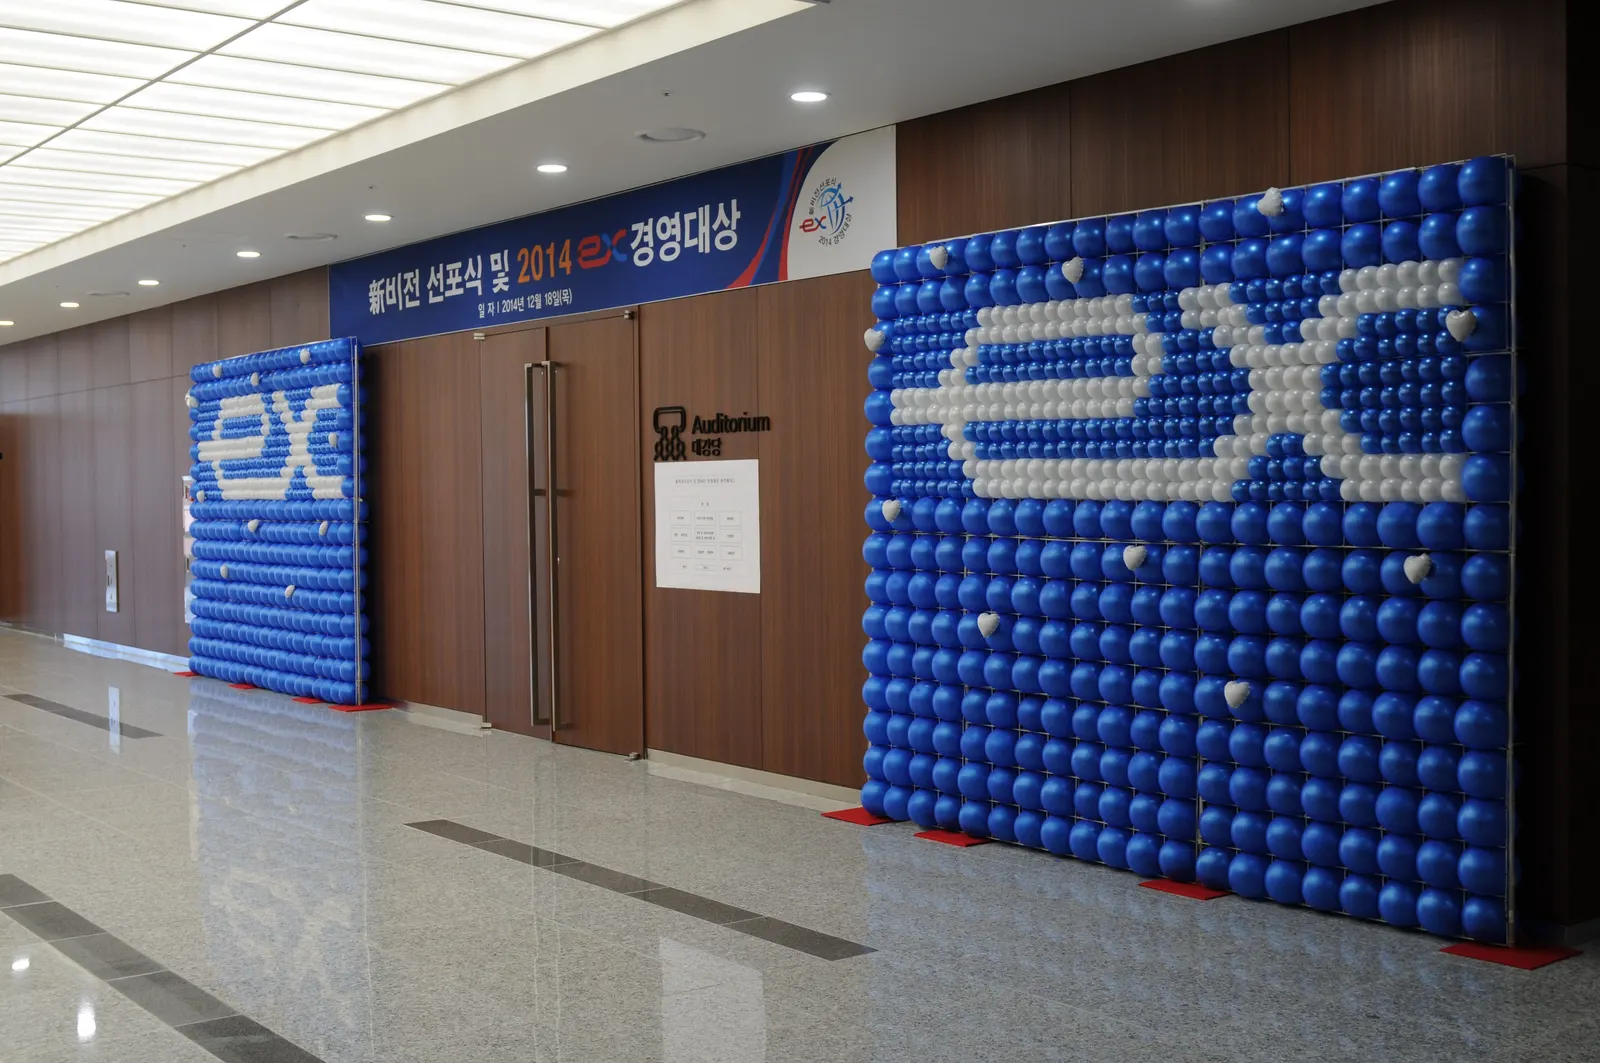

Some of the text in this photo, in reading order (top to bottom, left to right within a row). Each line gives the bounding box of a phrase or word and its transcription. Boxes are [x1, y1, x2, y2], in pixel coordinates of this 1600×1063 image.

[799, 215, 827, 233] ex
[368, 198, 741, 315] 新비전 선포식 및 2014 ex 경영대상
[501, 296, 525, 313] 2014년
[527, 293, 542, 310] 12월
[544, 287, 573, 307] 18일(목)
[889, 257, 1465, 503] ex
[691, 411, 770, 434] Auditorium
[691, 438, 721, 456] 대강당
